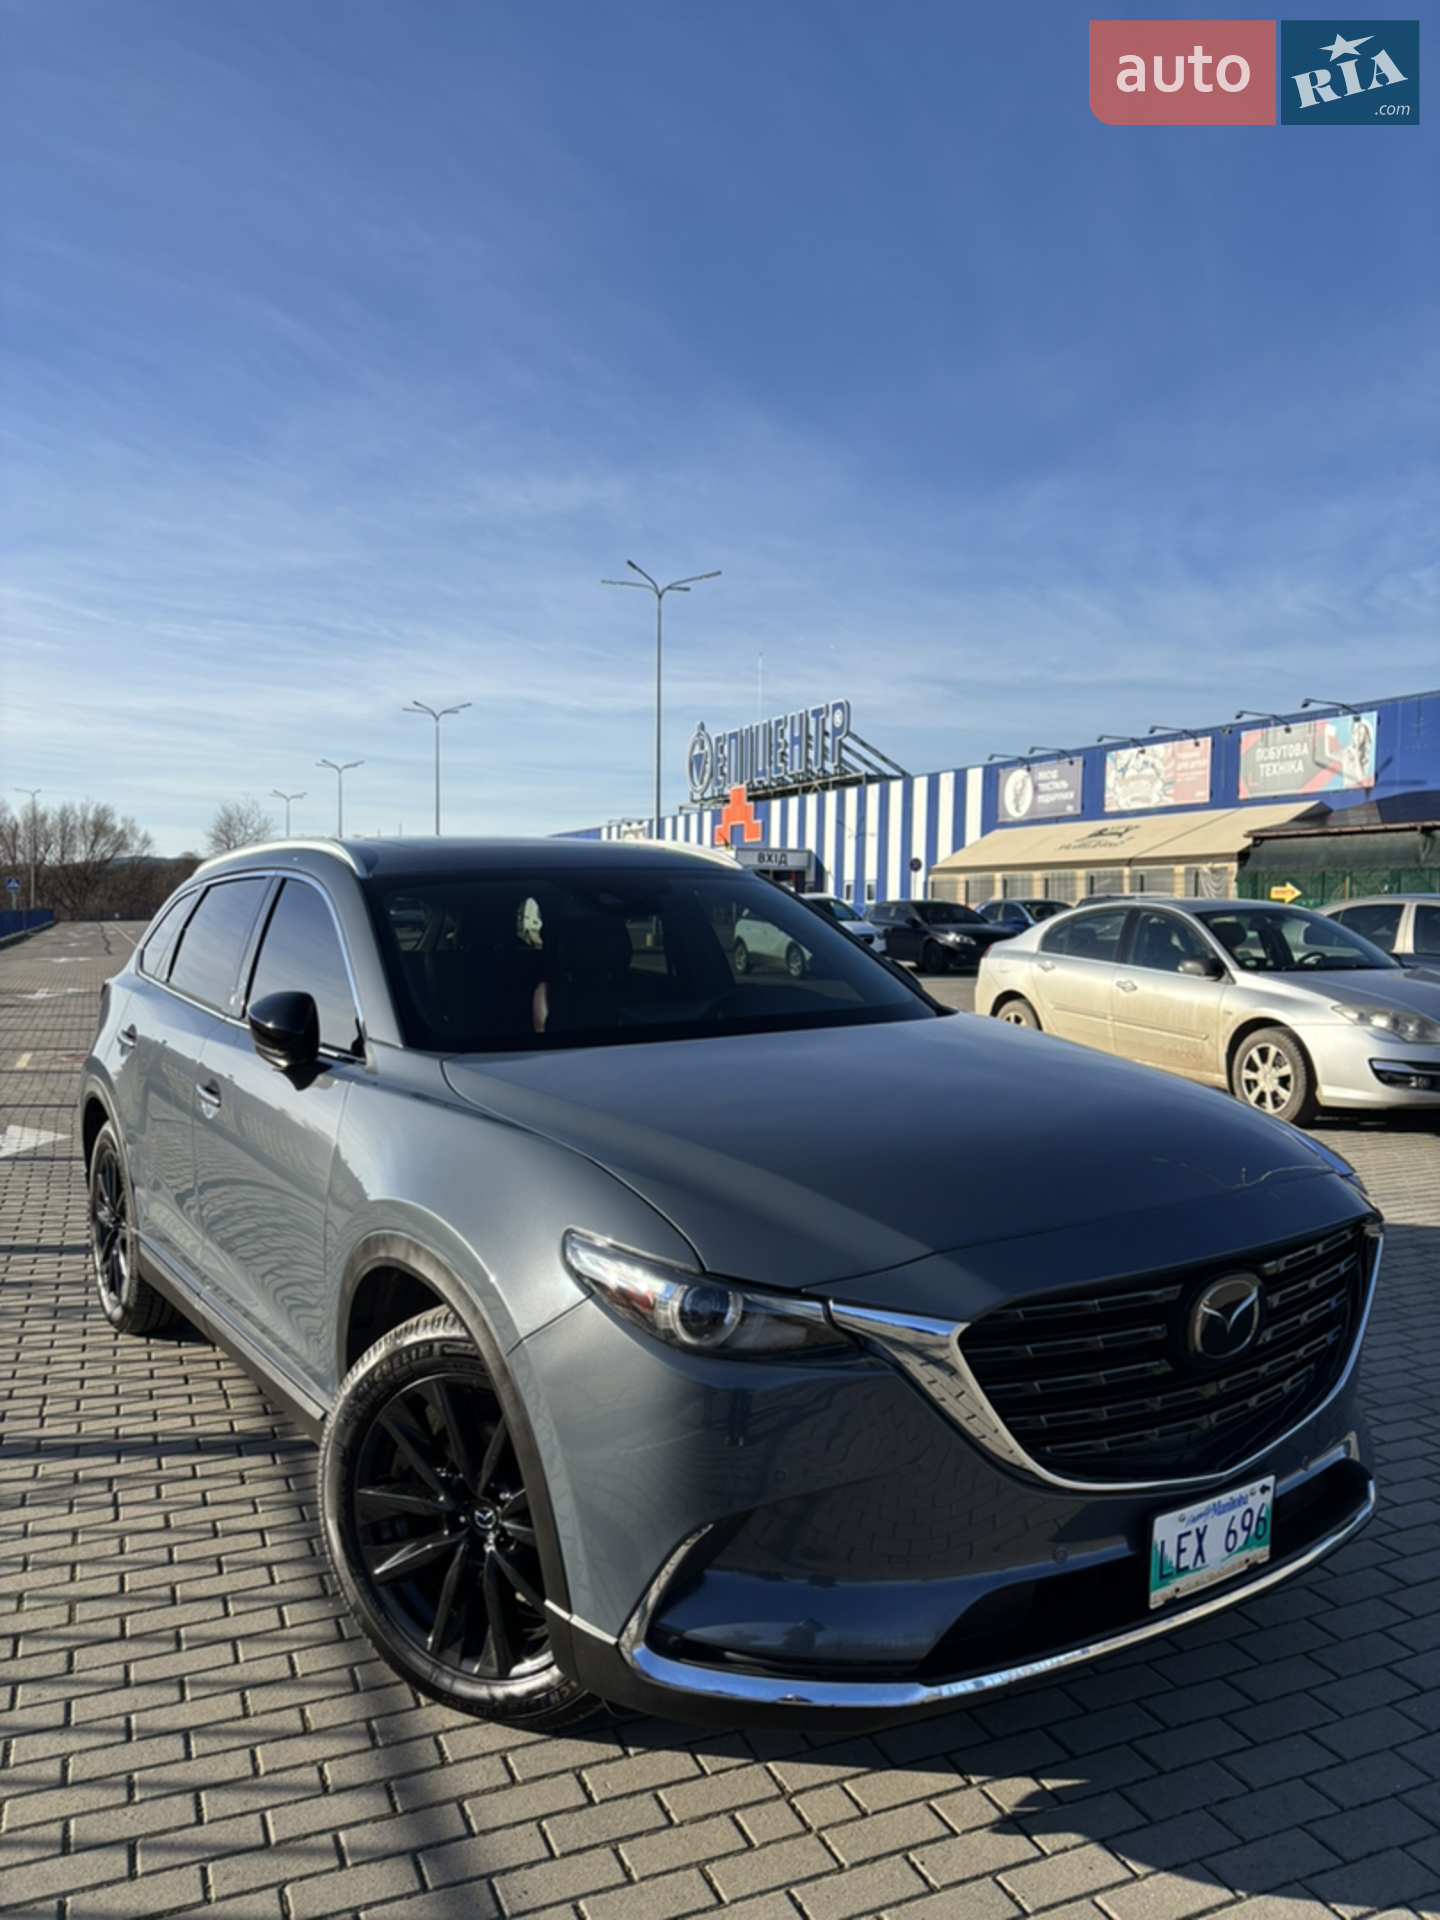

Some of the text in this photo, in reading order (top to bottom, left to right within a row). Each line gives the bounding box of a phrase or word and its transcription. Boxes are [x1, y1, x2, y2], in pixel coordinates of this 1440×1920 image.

[713, 698, 850, 790] ЕПІЦЕНТР
[1255, 741, 1309, 762] ПОБУТОВА
[1259, 760, 1304, 777] ТЕХНІКА
[757, 852, 788, 866] ВХІД
[1159, 1502, 1268, 1580] LEX 696
